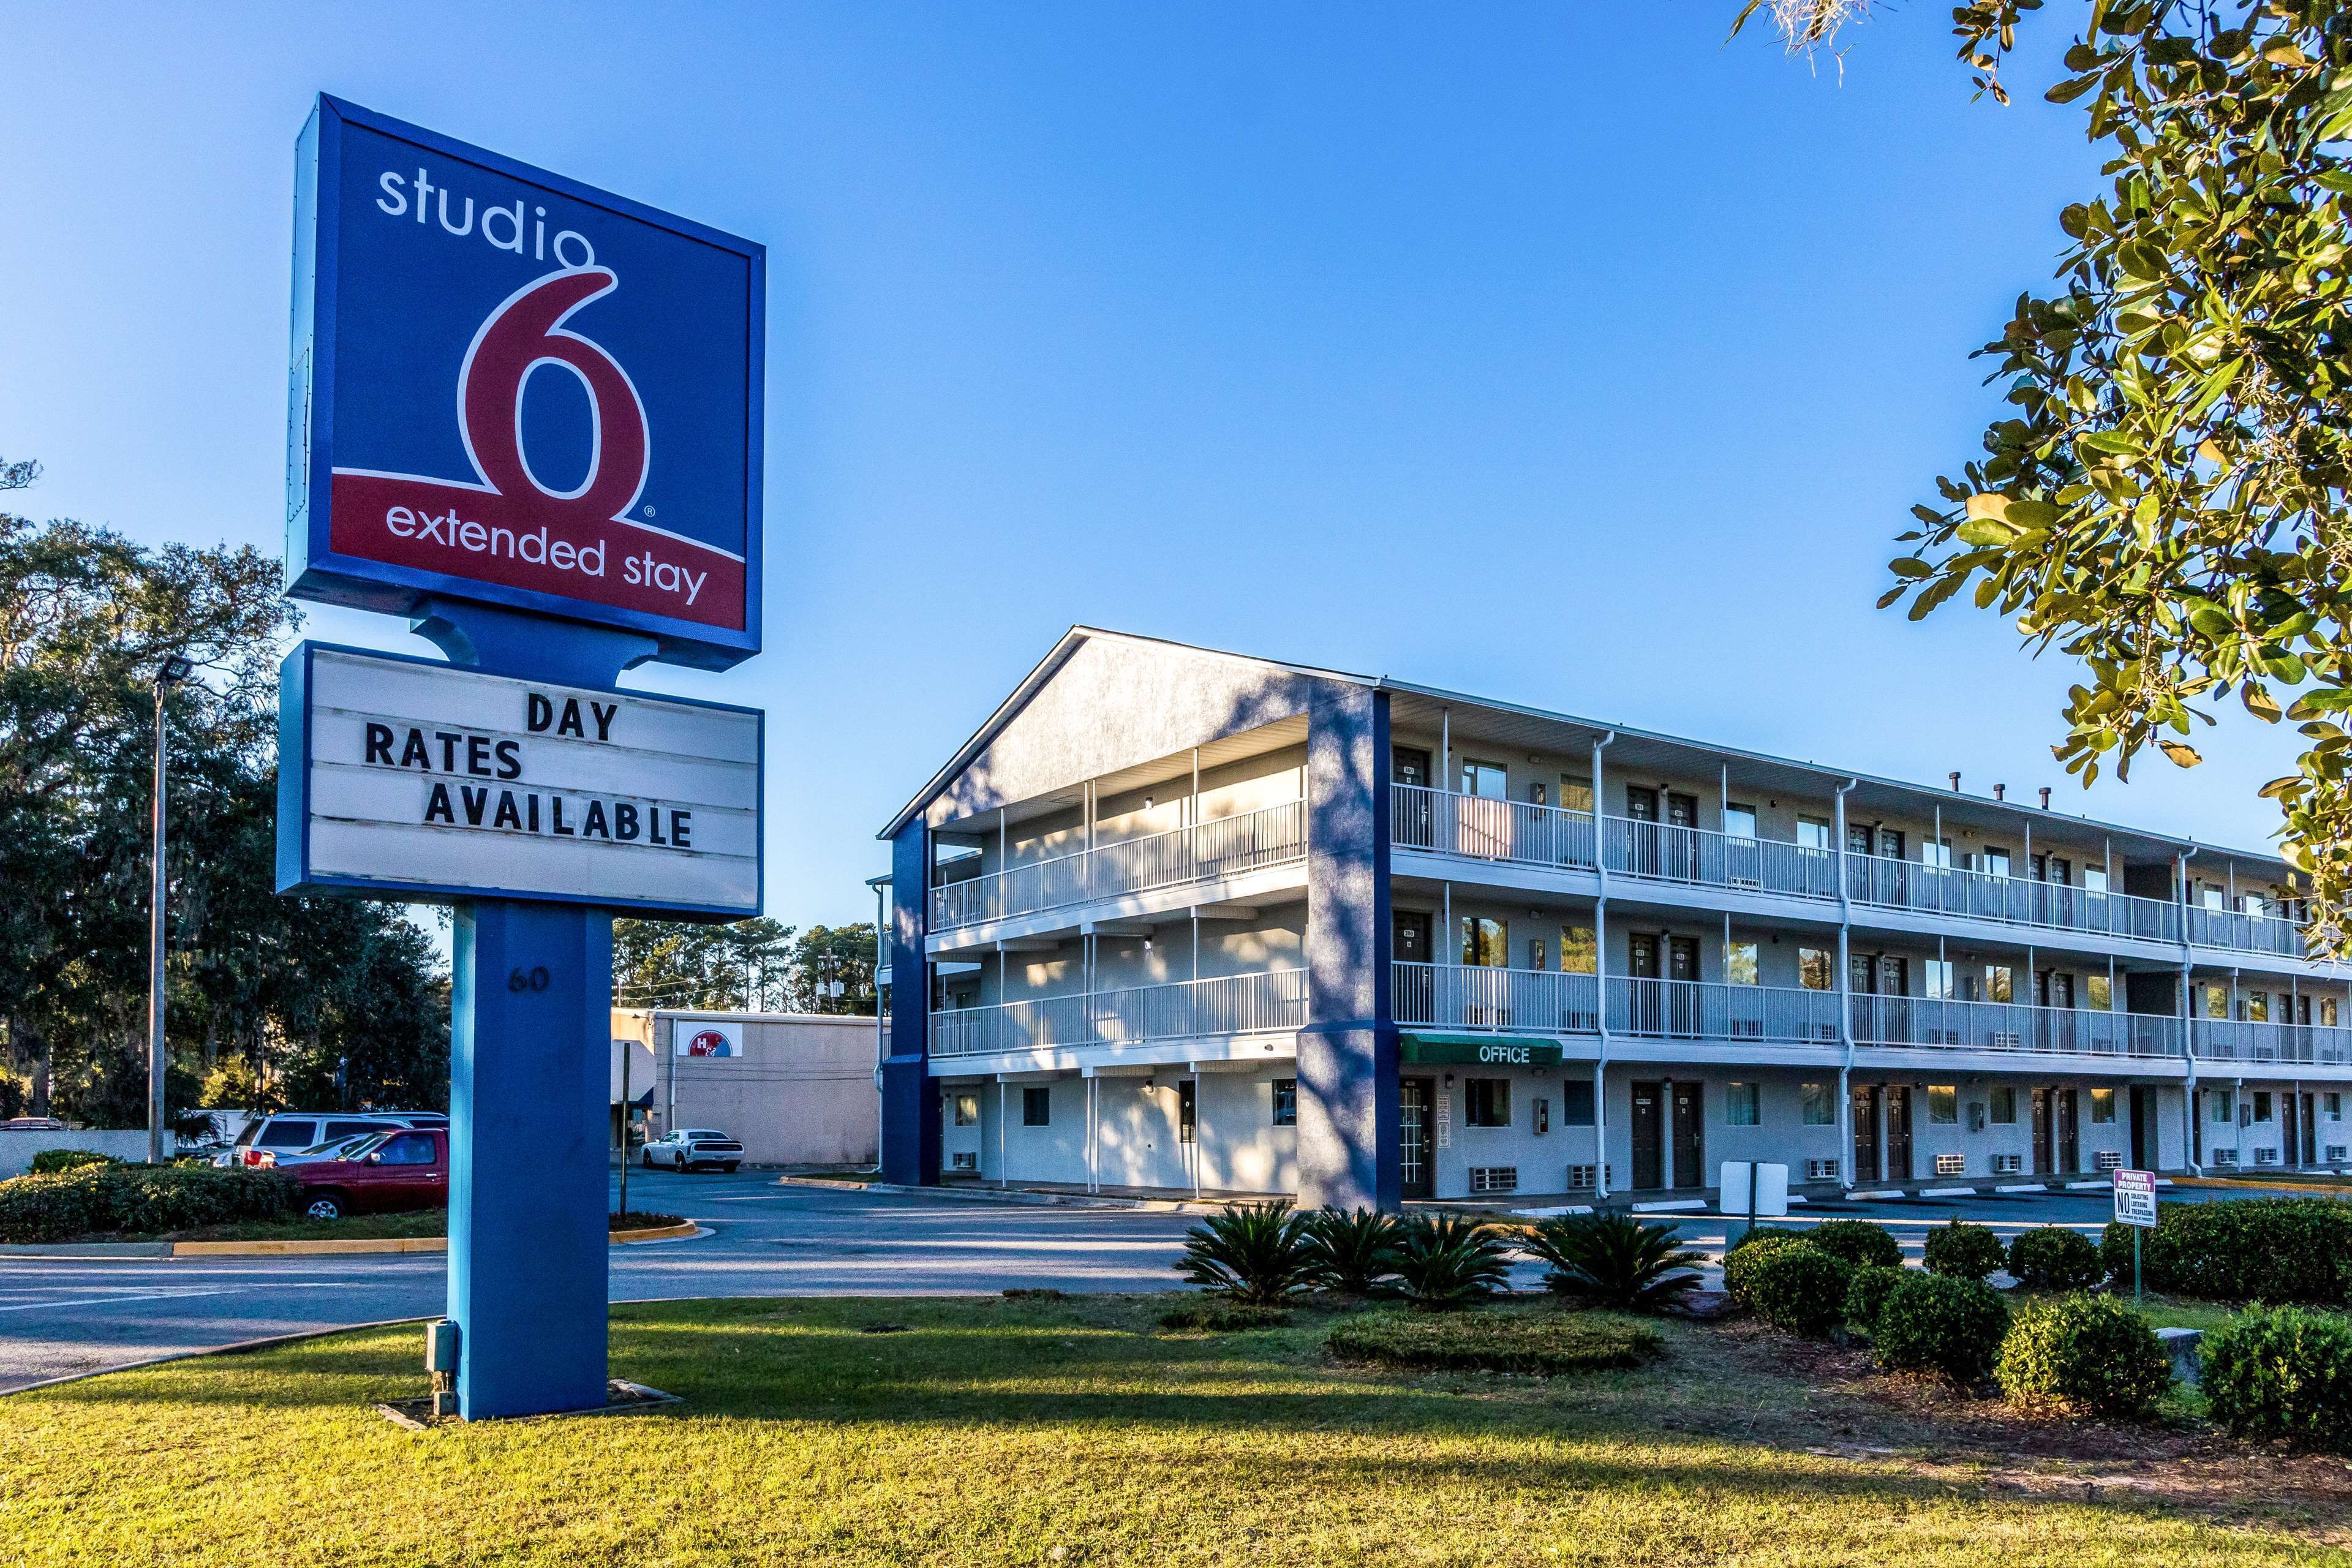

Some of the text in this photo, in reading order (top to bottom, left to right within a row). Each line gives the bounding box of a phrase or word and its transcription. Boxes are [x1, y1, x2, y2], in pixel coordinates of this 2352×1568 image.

[376, 168, 595, 269] studio
[458, 266, 650, 519] 6
[387, 505, 706, 605] extended stay
[527, 693, 617, 741] DAY
[366, 723, 521, 778] RATES
[424, 783, 691, 847] AVAILABLE
[510, 967, 549, 992] 60
[1480, 1046, 1529, 1063] OFFICE
[2118, 1181, 2150, 1191] PROPERTY
[2122, 1172, 2147, 1182] PRIVATE
[2117, 1192, 2130, 1214] NO
